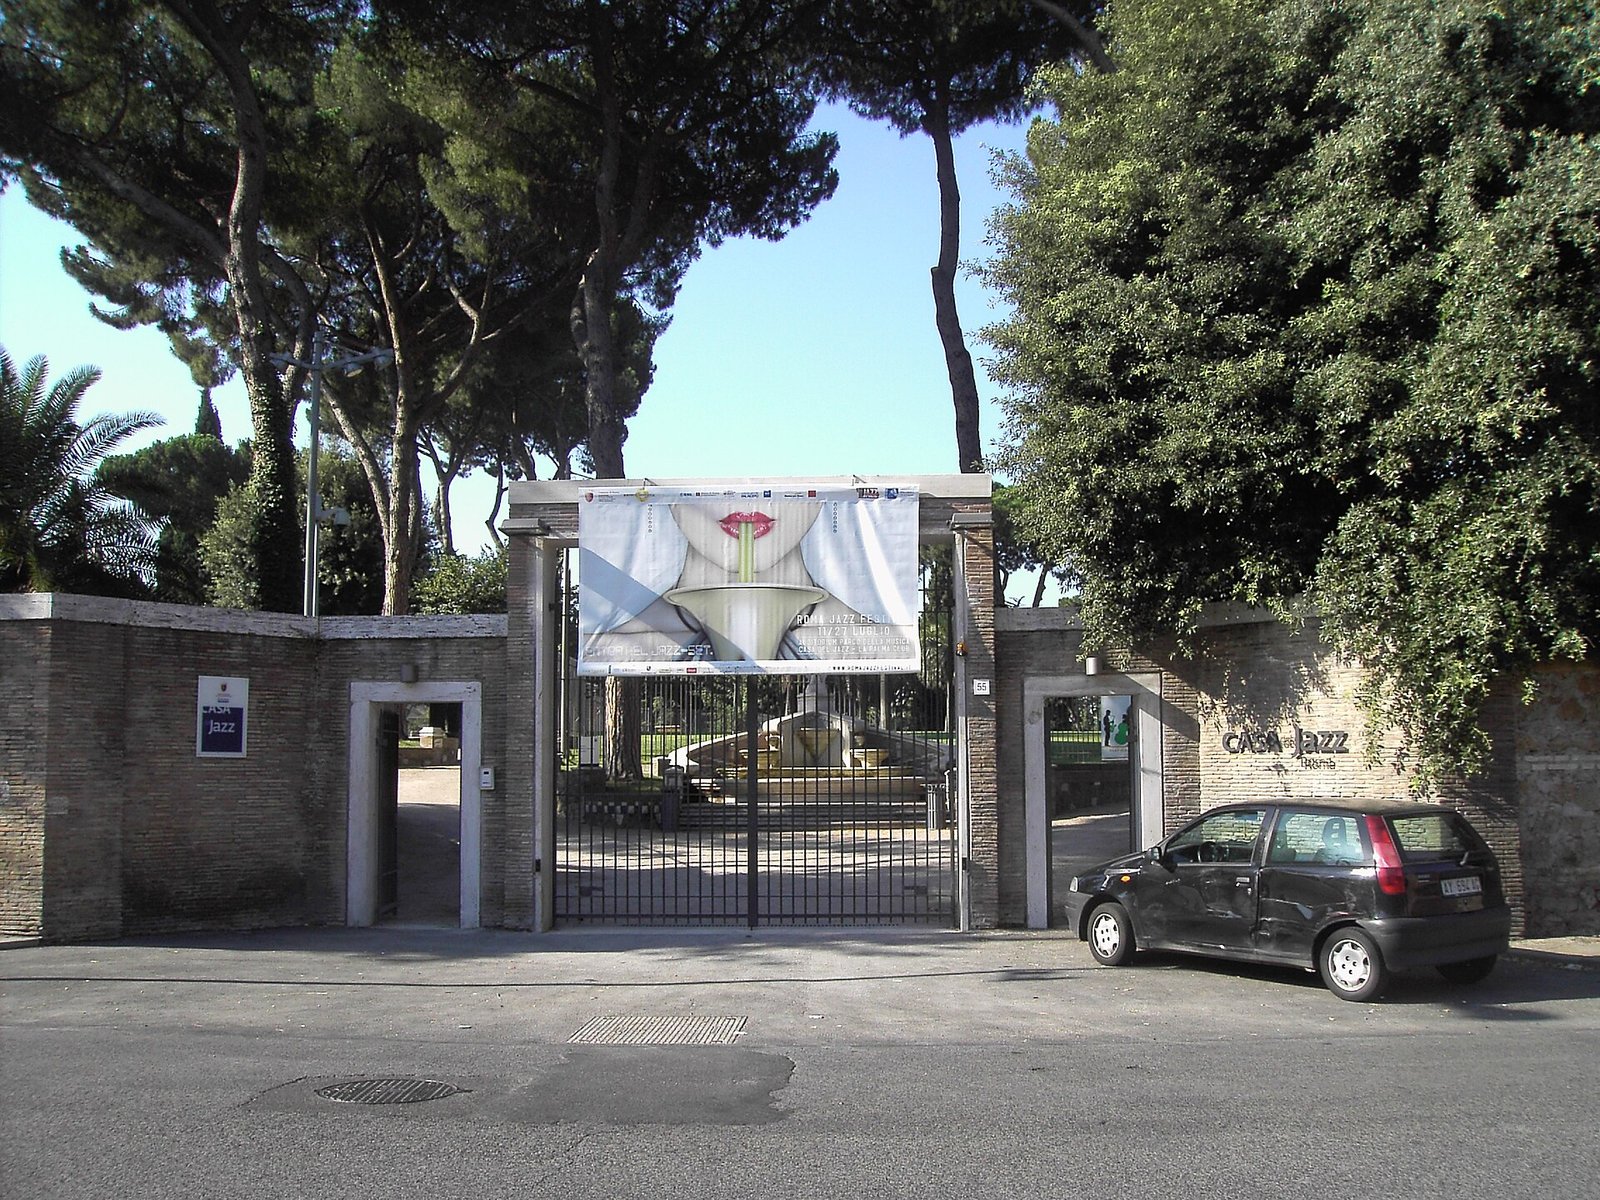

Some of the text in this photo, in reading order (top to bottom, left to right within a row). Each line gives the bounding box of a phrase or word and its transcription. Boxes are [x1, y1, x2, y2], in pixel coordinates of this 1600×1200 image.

[796, 614, 824, 625] ROMA
[829, 614, 856, 624] JAZZ
[817, 626, 890, 636] 11/27 LUGLIO
[833, 645, 850, 653] JAZZ
[976, 682, 987, 691] 55
[208, 719, 236, 735] Jazz
[1221, 731, 1283, 754] CASA
[1291, 722, 1350, 759] Jazz
